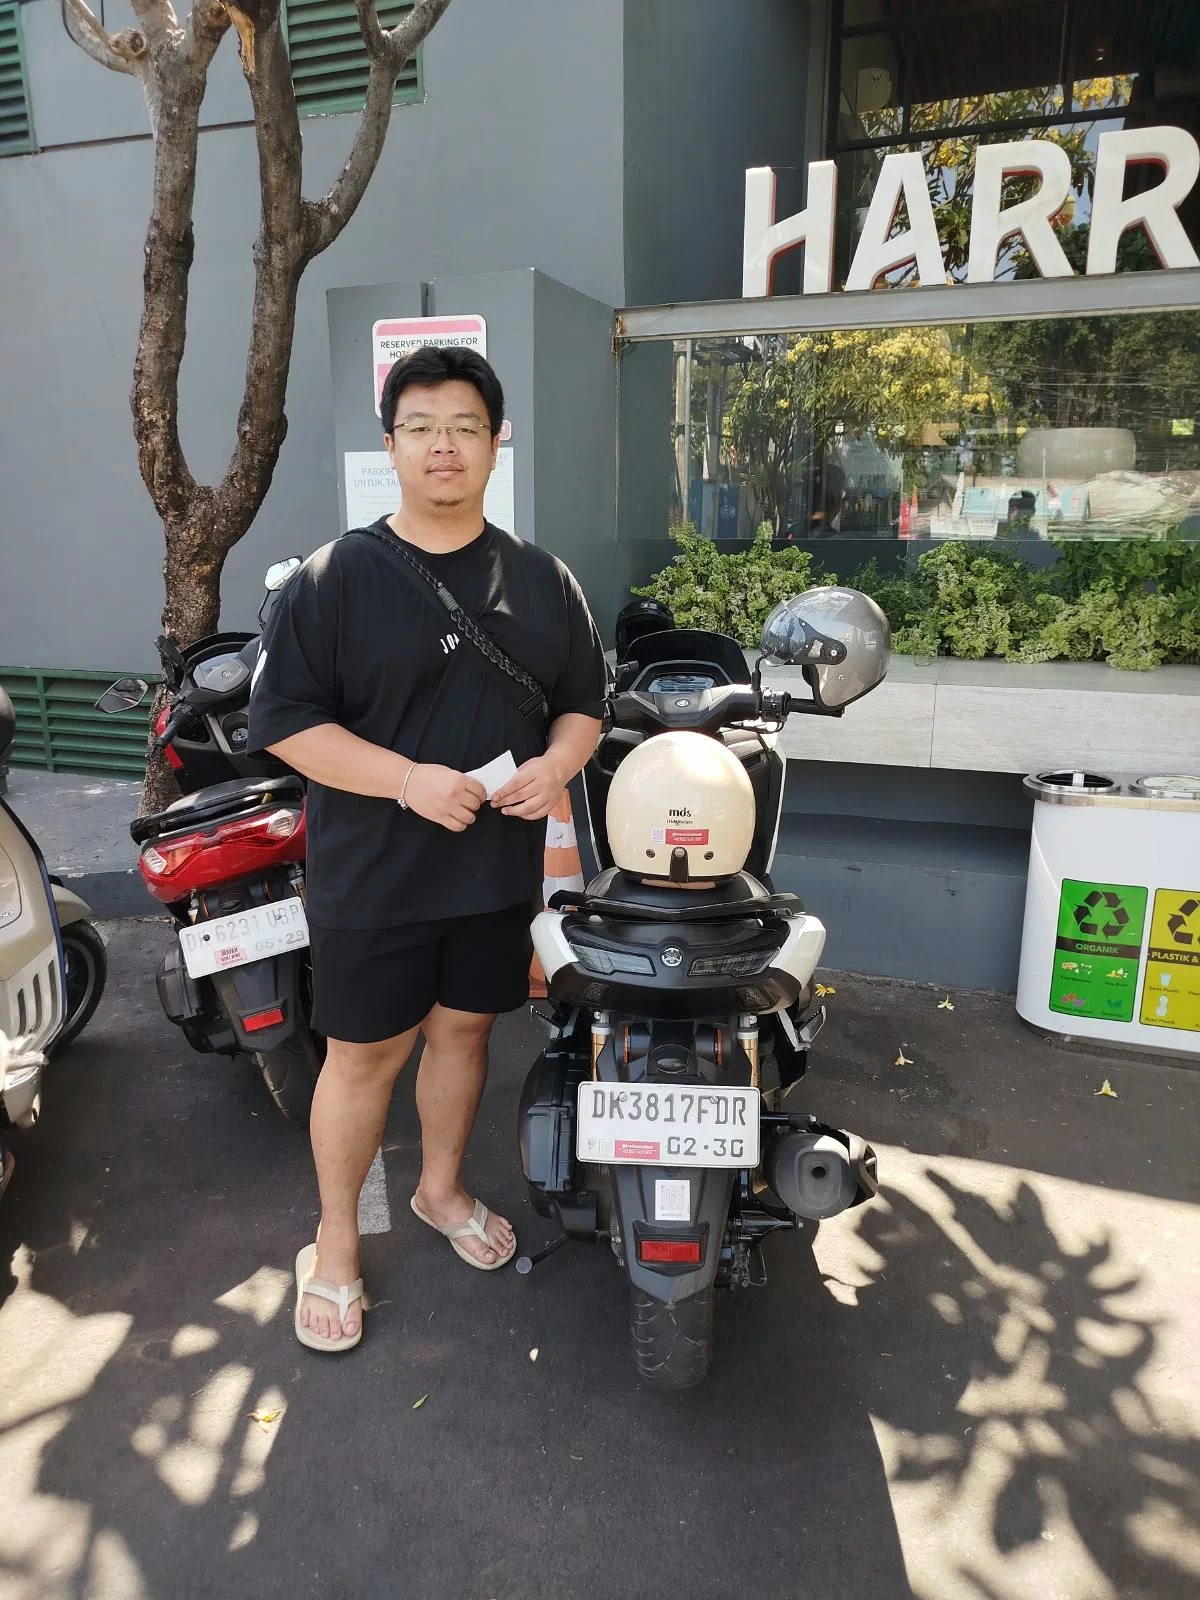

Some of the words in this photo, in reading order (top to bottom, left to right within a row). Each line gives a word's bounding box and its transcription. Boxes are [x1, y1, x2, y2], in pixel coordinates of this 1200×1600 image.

[742, 126, 1200, 297] HARR
[380, 339, 422, 348] RESERVED
[423, 337, 460, 347] PARKING
[461, 337, 478, 345] FOR
[354, 478, 384, 488] UNTUK
[669, 806, 692, 817] mds
[215, 914, 261, 943] 6231
[1075, 943, 1120, 954] ORGANIK
[1151, 951, 1190, 962] PLASTIK
[1191, 955, 1199, 963] &
